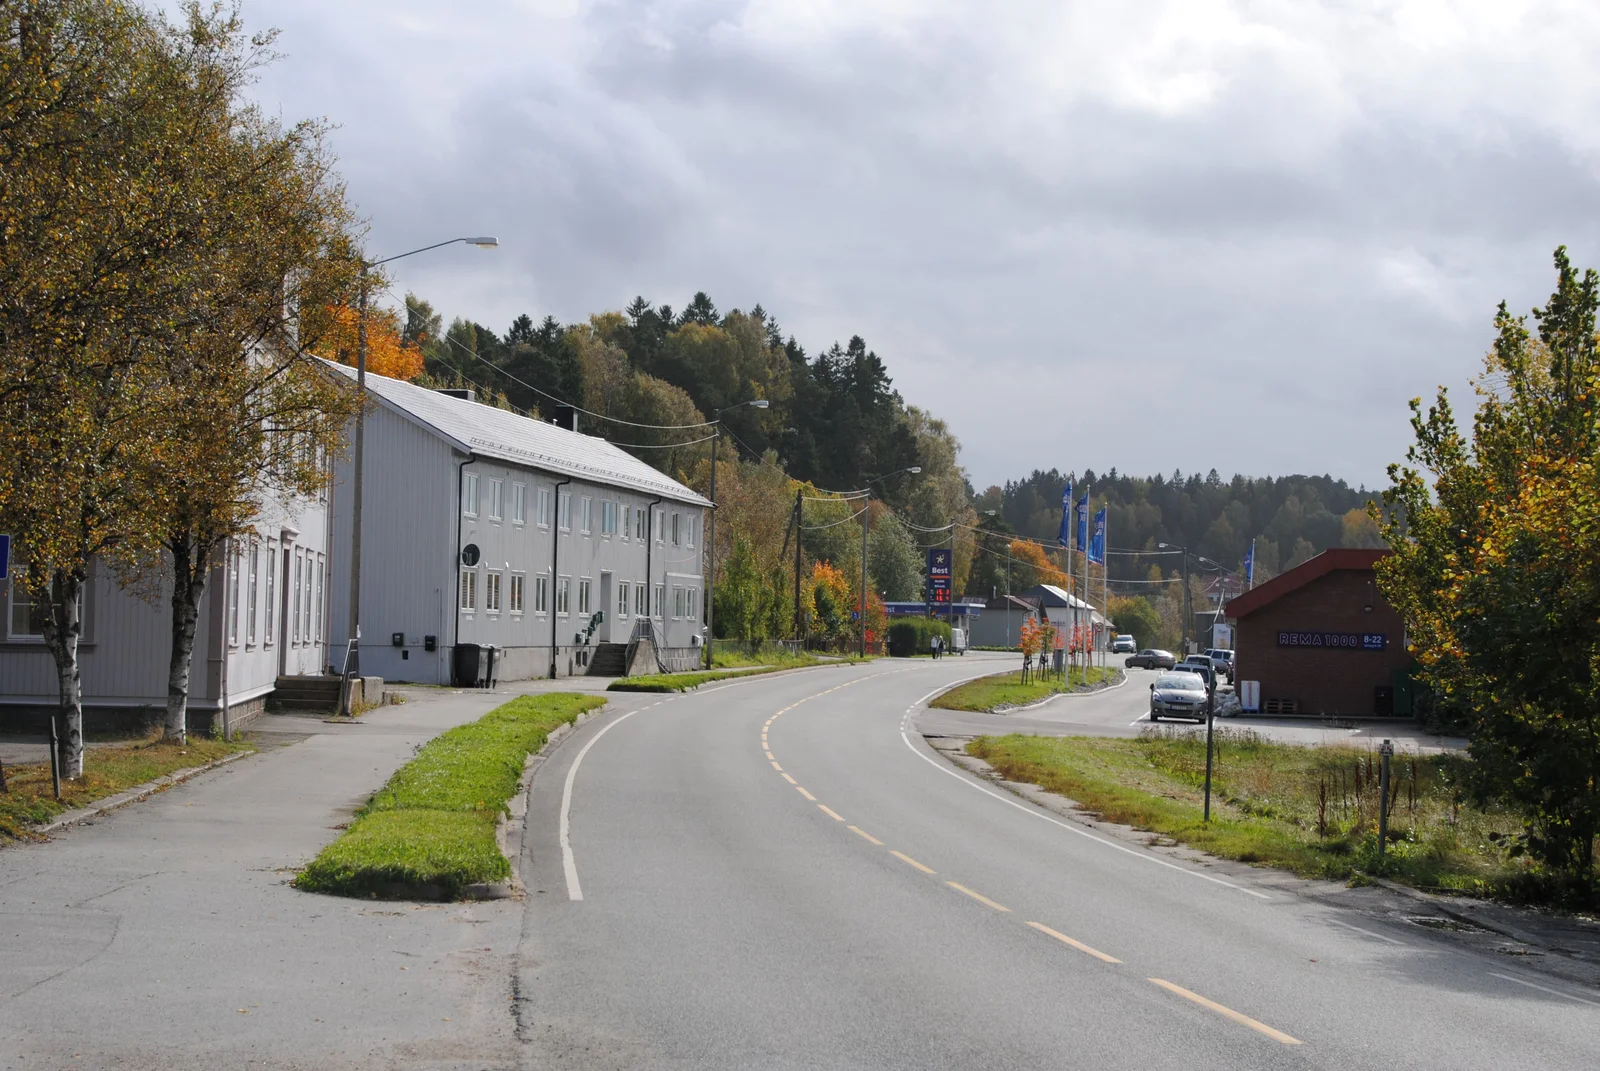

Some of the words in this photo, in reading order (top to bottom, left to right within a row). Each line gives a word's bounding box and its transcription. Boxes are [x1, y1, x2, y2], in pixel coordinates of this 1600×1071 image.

[1279, 633, 1322, 645] REMA
[1325, 635, 1358, 647] 1000
[1363, 635, 1382, 643] 8-22
